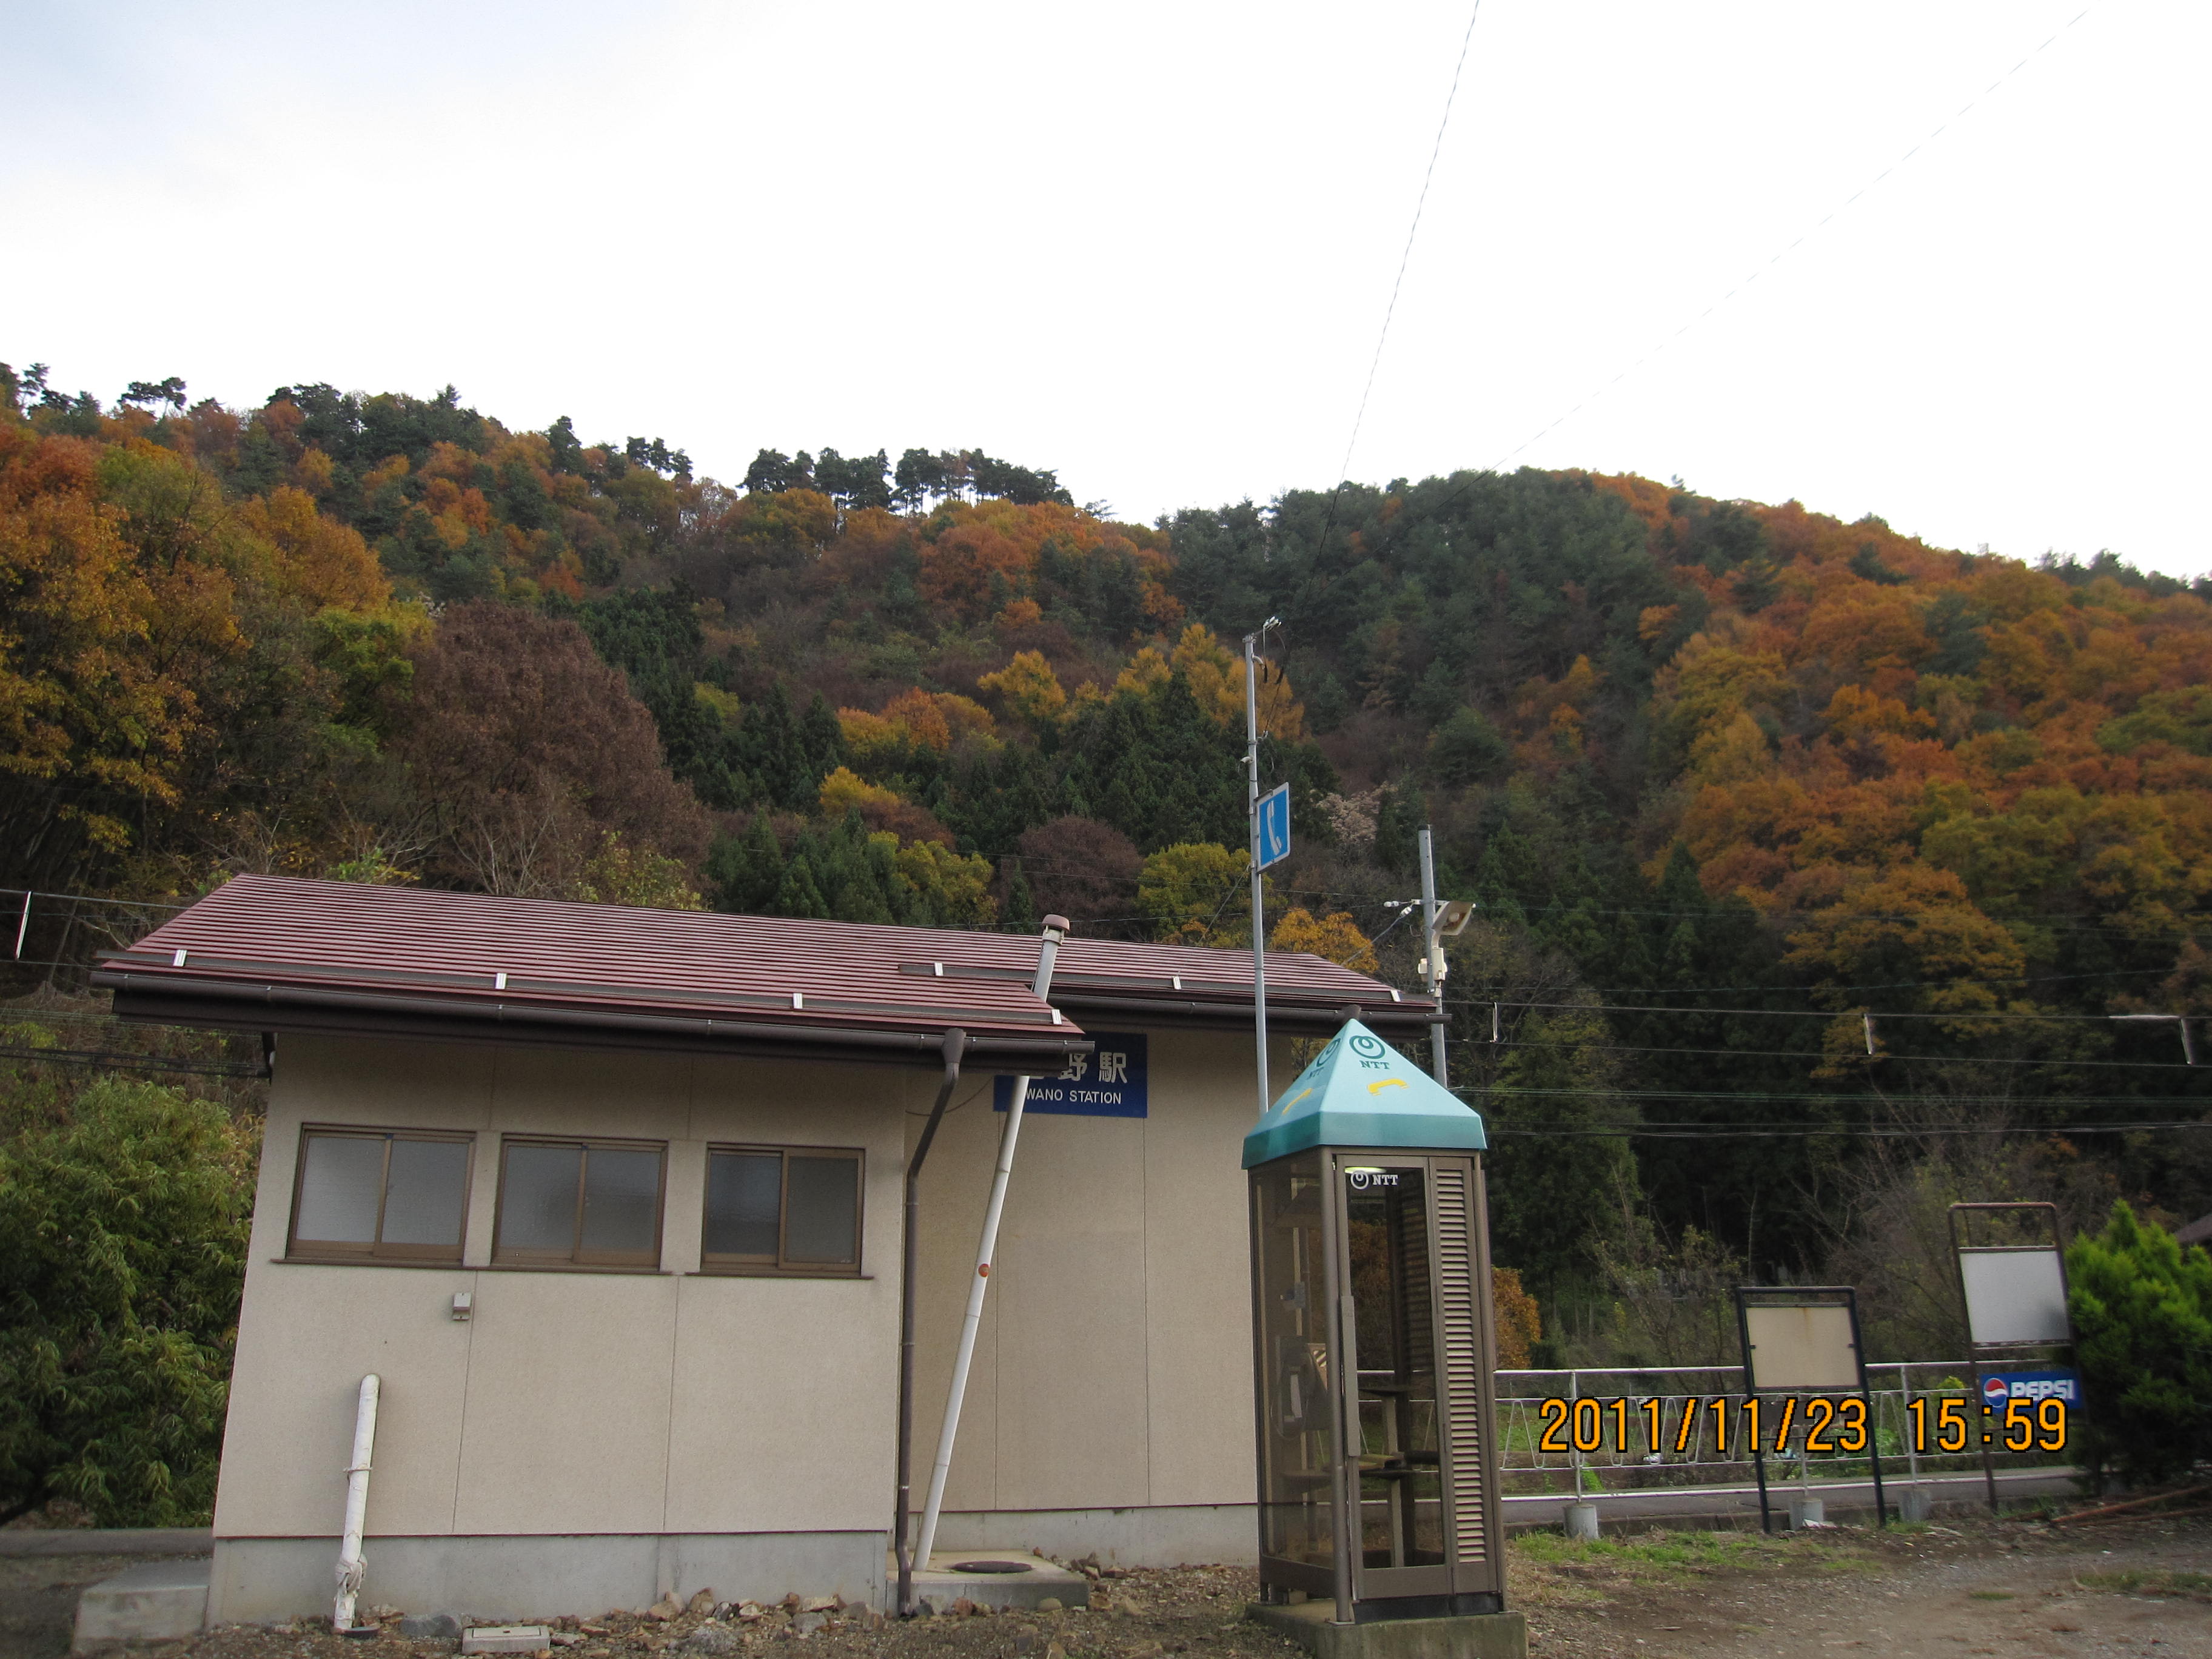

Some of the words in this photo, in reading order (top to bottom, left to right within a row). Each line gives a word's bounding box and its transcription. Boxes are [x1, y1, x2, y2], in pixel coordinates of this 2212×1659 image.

[1029, 1052, 1128, 1084] 野駅
[1359, 1061, 1390, 1070] NTT
[1026, 1088, 1063, 1101] WANO
[1069, 1090, 1122, 1104] STATION
[1372, 1174, 1398, 1185] NTT
[2011, 1379, 2075, 1401] PEPSI
